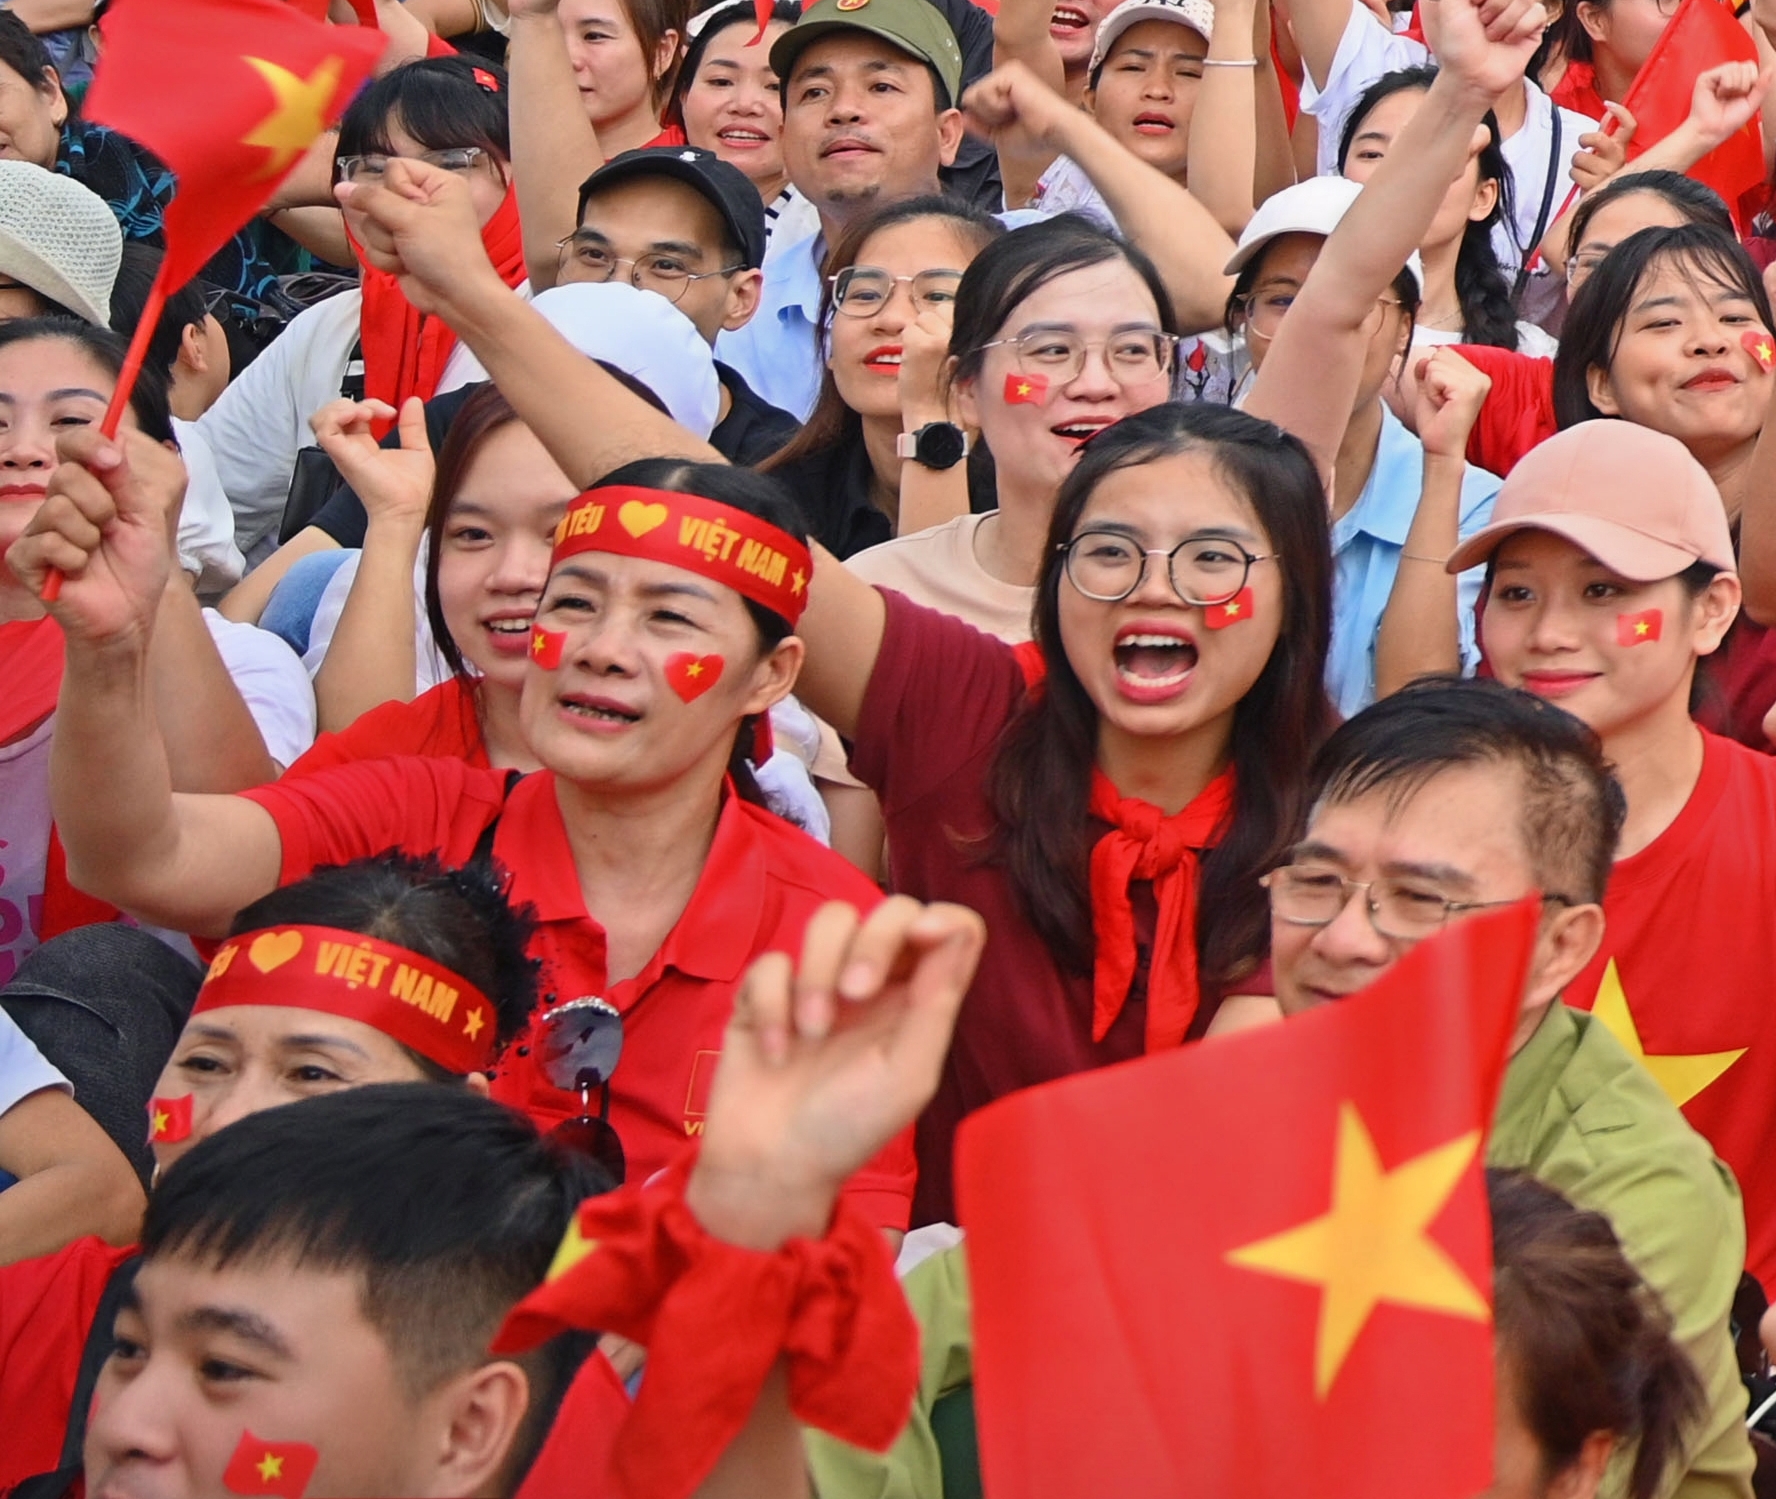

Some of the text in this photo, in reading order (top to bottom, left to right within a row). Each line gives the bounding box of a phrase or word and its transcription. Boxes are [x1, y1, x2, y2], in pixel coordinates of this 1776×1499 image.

[678, 513, 744, 564] VIỆT
[736, 538, 789, 585] NAM
[314, 938, 386, 990] VIỆT
[388, 961, 460, 1023] NAM
